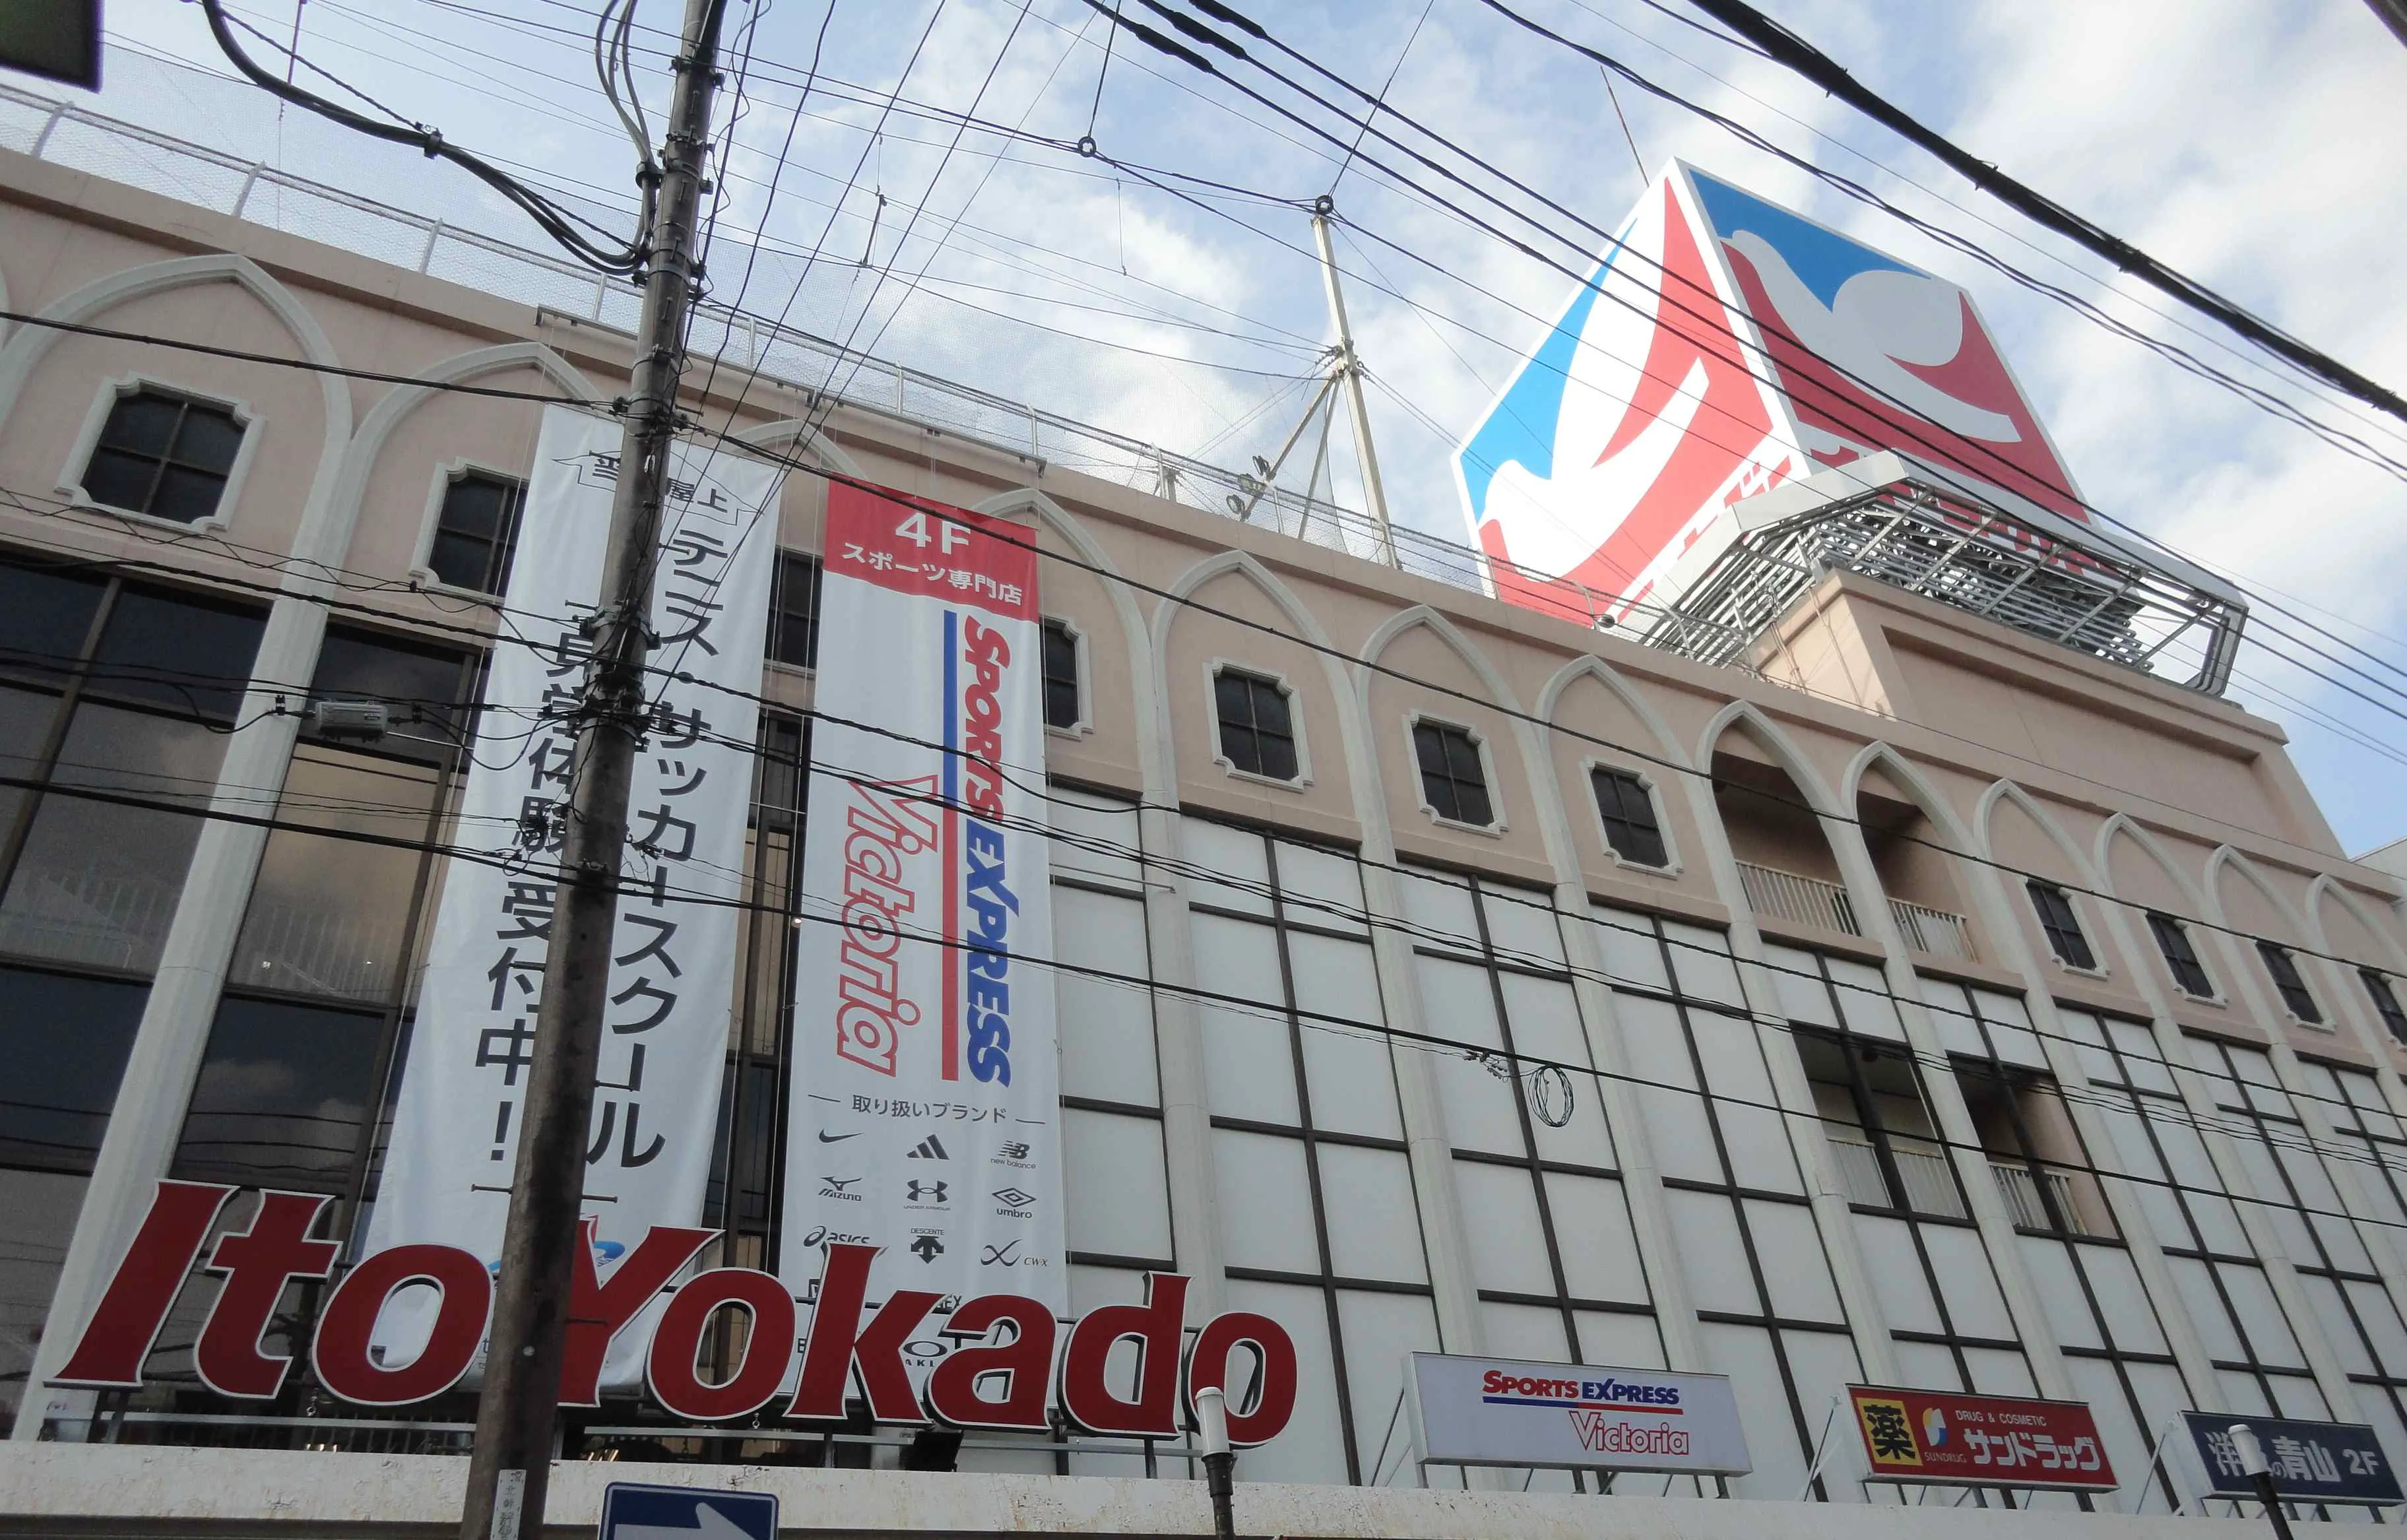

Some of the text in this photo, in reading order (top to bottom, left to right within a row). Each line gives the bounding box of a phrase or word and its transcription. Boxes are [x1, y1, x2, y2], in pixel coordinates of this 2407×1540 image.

[895, 512, 971, 555] 4F
[842, 542, 1023, 606] スポーツ専門店
[964, 614, 1019, 1088] SPORTS EXPRESS
[836, 774, 938, 1077] Victoria
[852, 1094, 1009, 1124] 取り扱いブランド
[1007, 1159, 1037, 1169] balance
[997, 1208, 1033, 1219] umbro
[1483, 1370, 1679, 1405] SPORTS EXPRESS
[1568, 1410, 1689, 1456] Victoria
[1863, 1404, 1917, 1460] 薬
[1955, 1409, 2047, 1427] DRUG & COSMETIC
[1924, 1452, 1966, 1463] SUNDRUG
[1964, 1428, 2101, 1471] サンドラッグ
[2203, 1431, 2379, 1483] 洋の青山 2F
